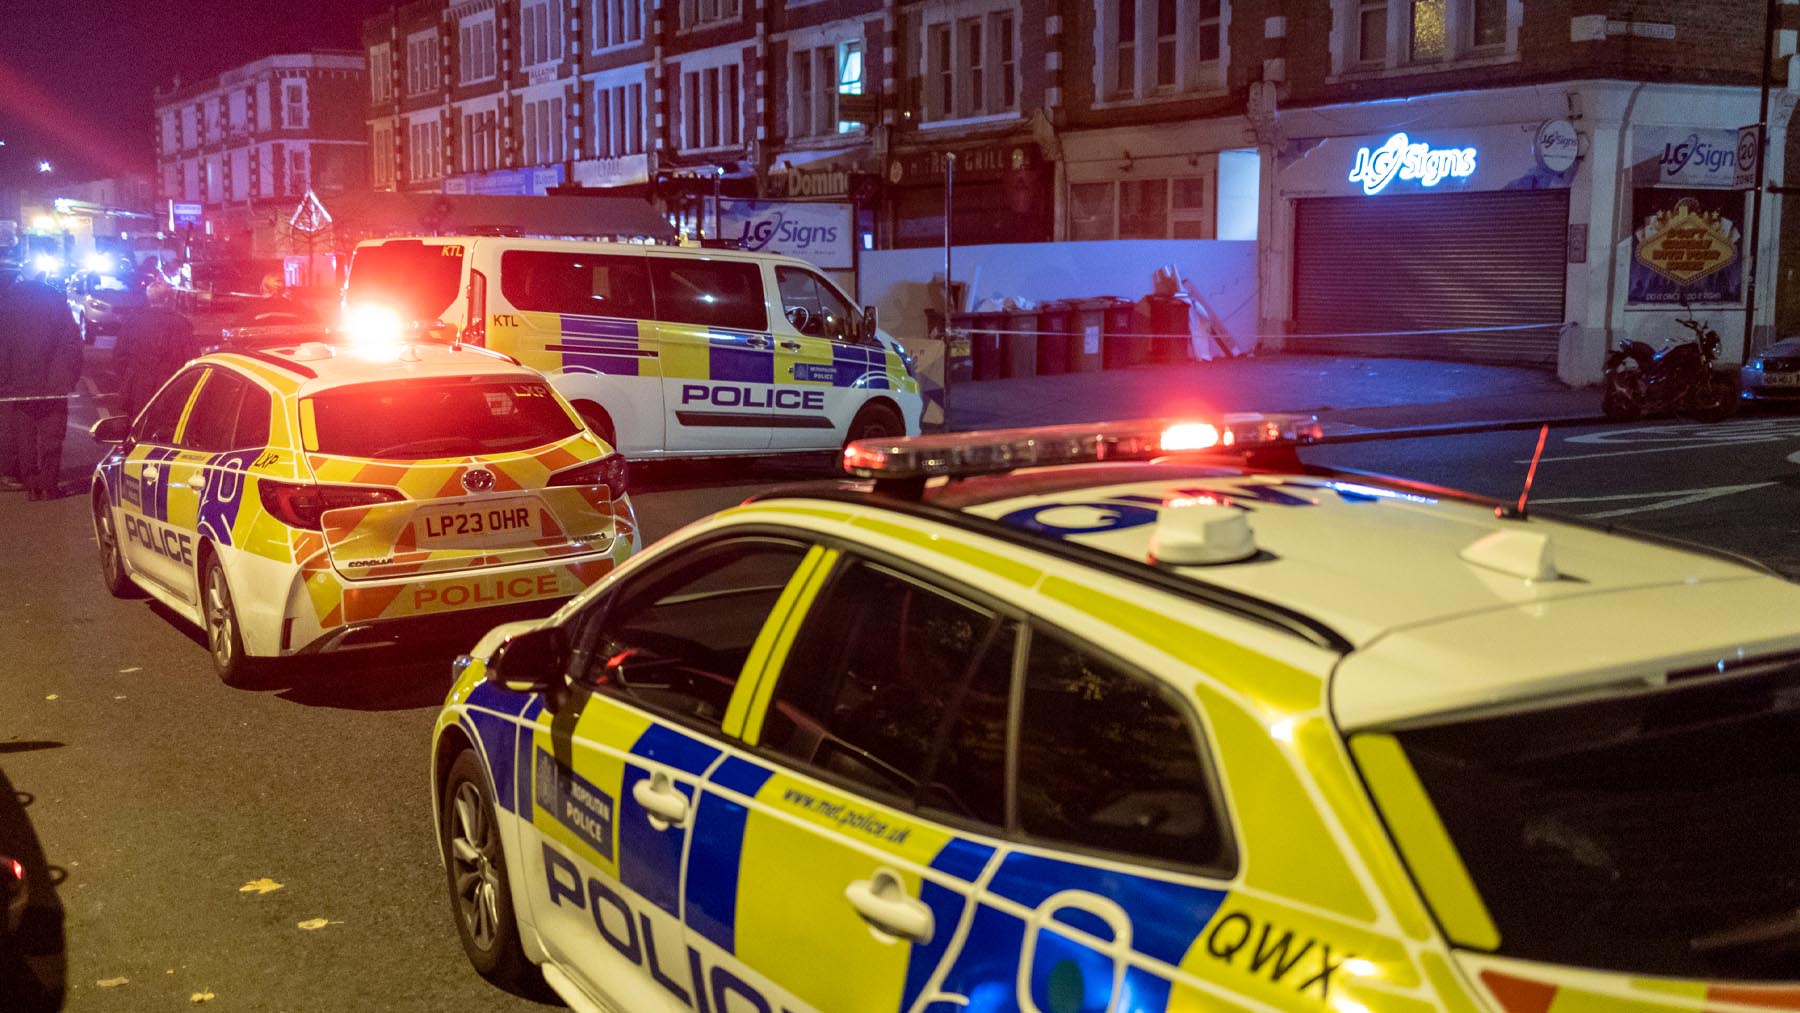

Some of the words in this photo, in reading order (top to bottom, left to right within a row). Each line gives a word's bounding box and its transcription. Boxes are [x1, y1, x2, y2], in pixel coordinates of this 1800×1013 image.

[1399, 142, 1477, 187] Signs
[1693, 143, 1737, 173] Sign
[1741, 143, 1754, 161] 20
[777, 220, 838, 248] Signs
[441, 244, 464, 257] KTL
[493, 314, 519, 327] KTL
[510, 384, 547, 398] LXP
[682, 384, 825, 411] POLICE
[254, 451, 280, 469] LXP
[426, 511, 483, 539] LP23
[488, 506, 530, 532] OHR
[124, 513, 194, 568] POLICE
[414, 573, 561, 610] POLICE
[566, 800, 603, 844] POLICE
[783, 787, 912, 845] www.met.police.uk
[542, 840, 795, 1013] POLIC
[1207, 911, 1351, 1000] QWX
